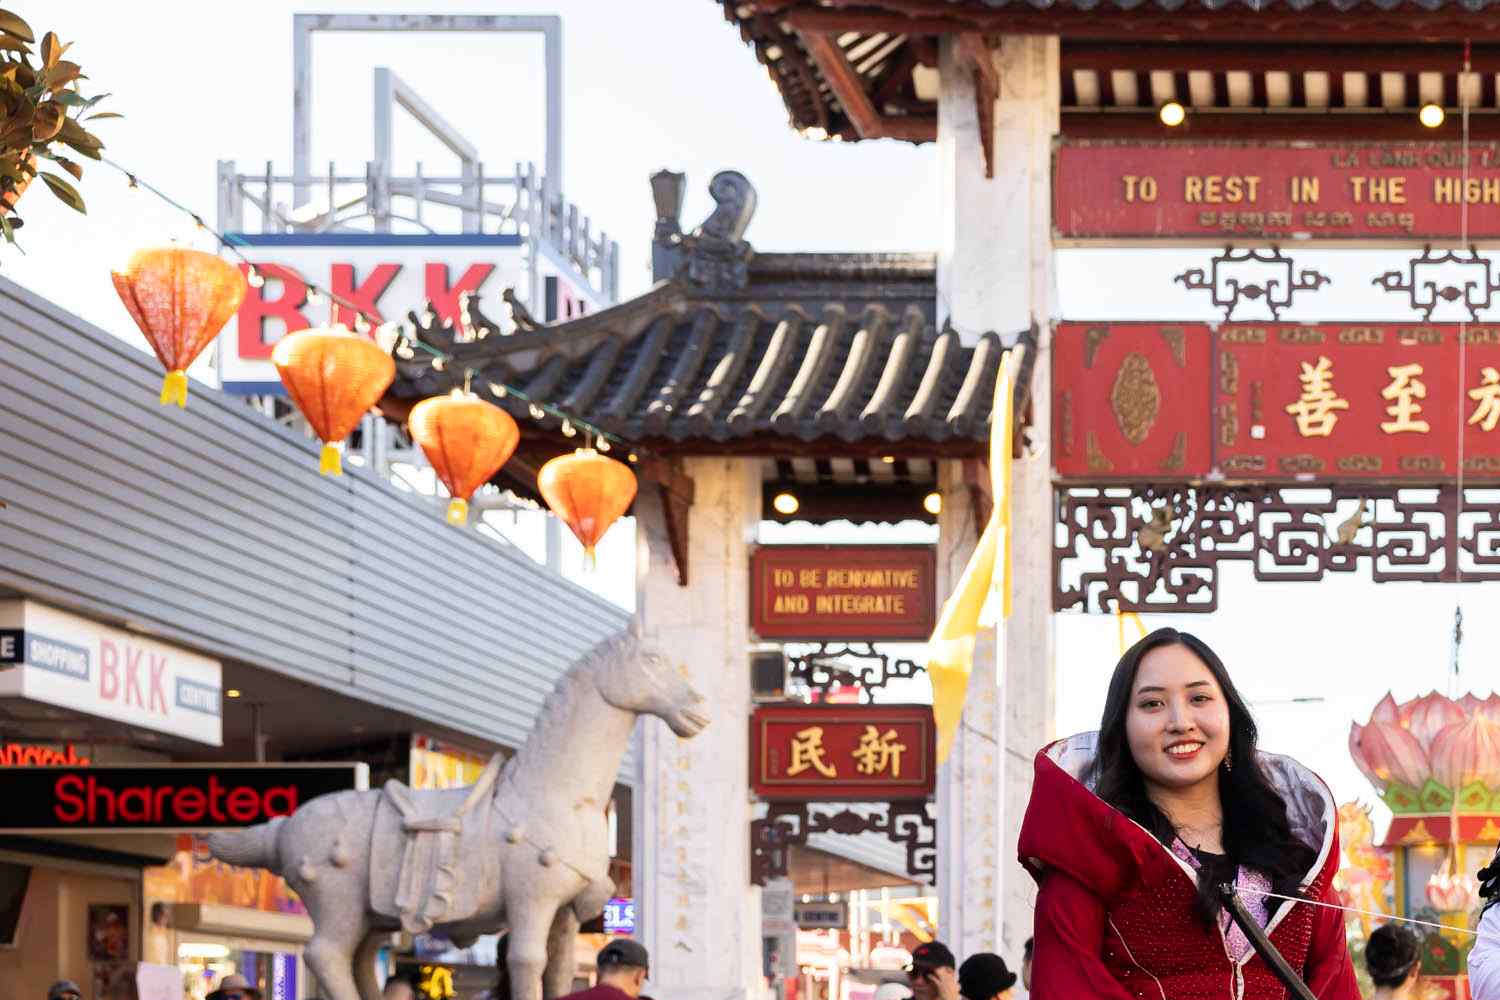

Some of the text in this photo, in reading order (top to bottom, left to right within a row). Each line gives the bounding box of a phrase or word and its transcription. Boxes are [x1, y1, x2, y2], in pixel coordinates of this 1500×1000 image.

[1122, 175, 1158, 203] TO
[1184, 175, 1261, 204] REST
[1290, 175, 1320, 203] IN
[1349, 175, 1407, 204] THE
[238, 263, 497, 358] BKK
[772, 568, 919, 588] TO BE RENOVATIVE
[774, 595, 905, 615] AND INTEGRATE
[100, 639, 168, 715] BKK
[54, 773, 297, 823] Sharetea
